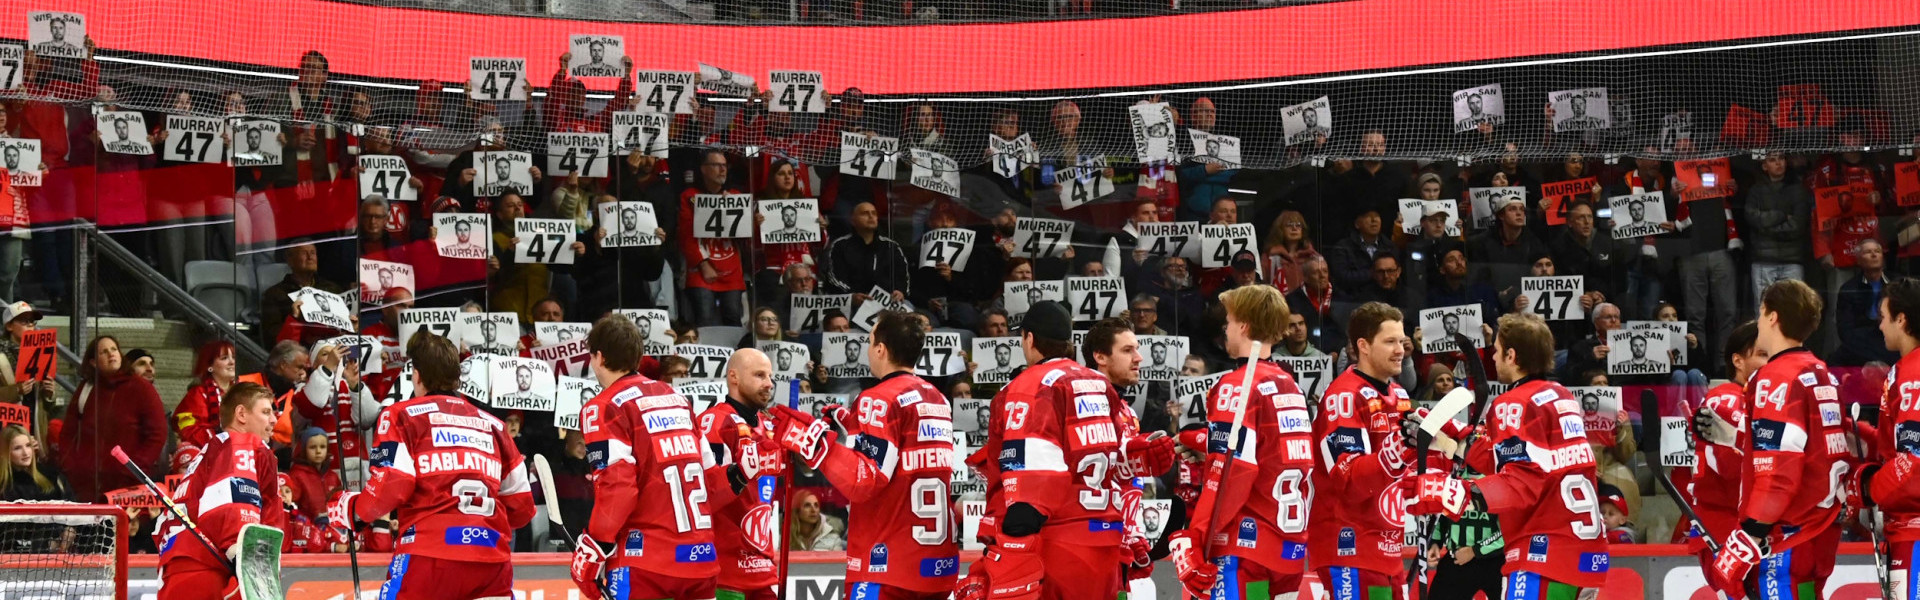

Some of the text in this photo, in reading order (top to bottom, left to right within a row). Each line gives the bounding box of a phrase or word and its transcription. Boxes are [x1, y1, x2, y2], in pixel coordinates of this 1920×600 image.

[33, 13, 81, 26] WIR SAN
[574, 37, 619, 47] WIR SAN
[32, 44, 84, 57] MURRAY!
[472, 60, 523, 71] MURRAY
[572, 67, 621, 77] MURRAY!
[639, 72, 692, 84] MURRAY
[771, 73, 822, 83] MURRAY
[480, 72, 517, 99] 47
[647, 85, 685, 112] 47
[779, 84, 816, 112] 47
[1453, 88, 1497, 103] WIR SAN
[1555, 91, 1602, 103] WIR SAN
[1287, 100, 1326, 117] WIR SAN
[99, 113, 141, 124] WIR SAN
[615, 114, 667, 127] MURRAY
[1557, 120, 1605, 130] MURRAY!
[169, 119, 221, 132] MURRAY
[259, 123, 277, 133] SAN
[551, 134, 606, 147] MURRAY
[624, 126, 660, 155] 47
[1130, 109, 1148, 159] MURRAY!
[16, 142, 35, 152] SAN
[176, 133, 214, 161] 47
[844, 135, 895, 150] MURRAY
[991, 136, 1028, 154] MURRAY
[1218, 137, 1235, 147] SAN
[107, 143, 150, 155] MURRAY!
[508, 152, 526, 163] SAN
[559, 149, 599, 176] 47
[850, 149, 885, 176] 47
[372, 171, 407, 199] 47
[914, 176, 958, 197] MURRAY!
[1071, 169, 1102, 203] 47
[1474, 190, 1491, 199] WIR
[697, 196, 751, 208] MURRAY
[765, 201, 813, 212] WIR SAN
[1405, 200, 1423, 210] WIR
[1612, 195, 1660, 208] WIR SAN
[633, 204, 650, 213] SAN
[439, 215, 486, 225] WIR SAN
[705, 209, 744, 237] 47
[1018, 221, 1072, 232] MURRAY
[518, 221, 572, 233] MURRAY
[1140, 225, 1195, 236] MURRAY
[1204, 226, 1252, 239] MURRAY
[764, 232, 817, 242] MURRAY!
[923, 230, 973, 242] MURRAY
[526, 234, 565, 263] 47
[1022, 232, 1061, 258] 47
[1149, 237, 1188, 258] 47
[363, 263, 409, 276] WIR SAN
[1010, 284, 1059, 294] WIR SAN
[1070, 280, 1123, 291] MURRAY
[1524, 278, 1580, 290] MURRAY
[794, 297, 849, 308] MURRAY
[1080, 292, 1117, 320] 47
[1533, 291, 1573, 319] 47
[400, 310, 456, 324] MURRAY
[464, 315, 513, 325] WIR SAN
[647, 311, 666, 322] SAN
[1425, 308, 1476, 321] WIR SAN
[307, 313, 350, 330] MURRAY!
[1662, 322, 1682, 333] SAN
[542, 325, 588, 335] WIR SAN
[1613, 331, 1664, 342] WIR SAN
[829, 335, 848, 344] WIR
[979, 340, 996, 350] WIR
[1164, 339, 1184, 349] SAN
[676, 345, 732, 357] MURRAY
[762, 344, 806, 357] WIR SAN
[24, 347, 54, 381] 47
[499, 361, 548, 374] WIR SAN
[690, 356, 727, 378] 47
[916, 348, 952, 375] 47
[1612, 364, 1666, 374] MURRAY!
[774, 374, 791, 383] SAN
[565, 381, 583, 390] WIR
[1596, 389, 1616, 398] SAN
[1755, 379, 1788, 411] 64
[496, 396, 551, 410] MURRAY!
[798, 397, 816, 406] WIR
[960, 401, 980, 410] WIR
[1326, 392, 1353, 421] 90
[858, 397, 888, 428] 92
[1495, 402, 1523, 430] 98
[582, 405, 599, 434] 12
[1667, 420, 1688, 430] WIR
[435, 430, 492, 450] Alpacem
[663, 462, 711, 533] 12
